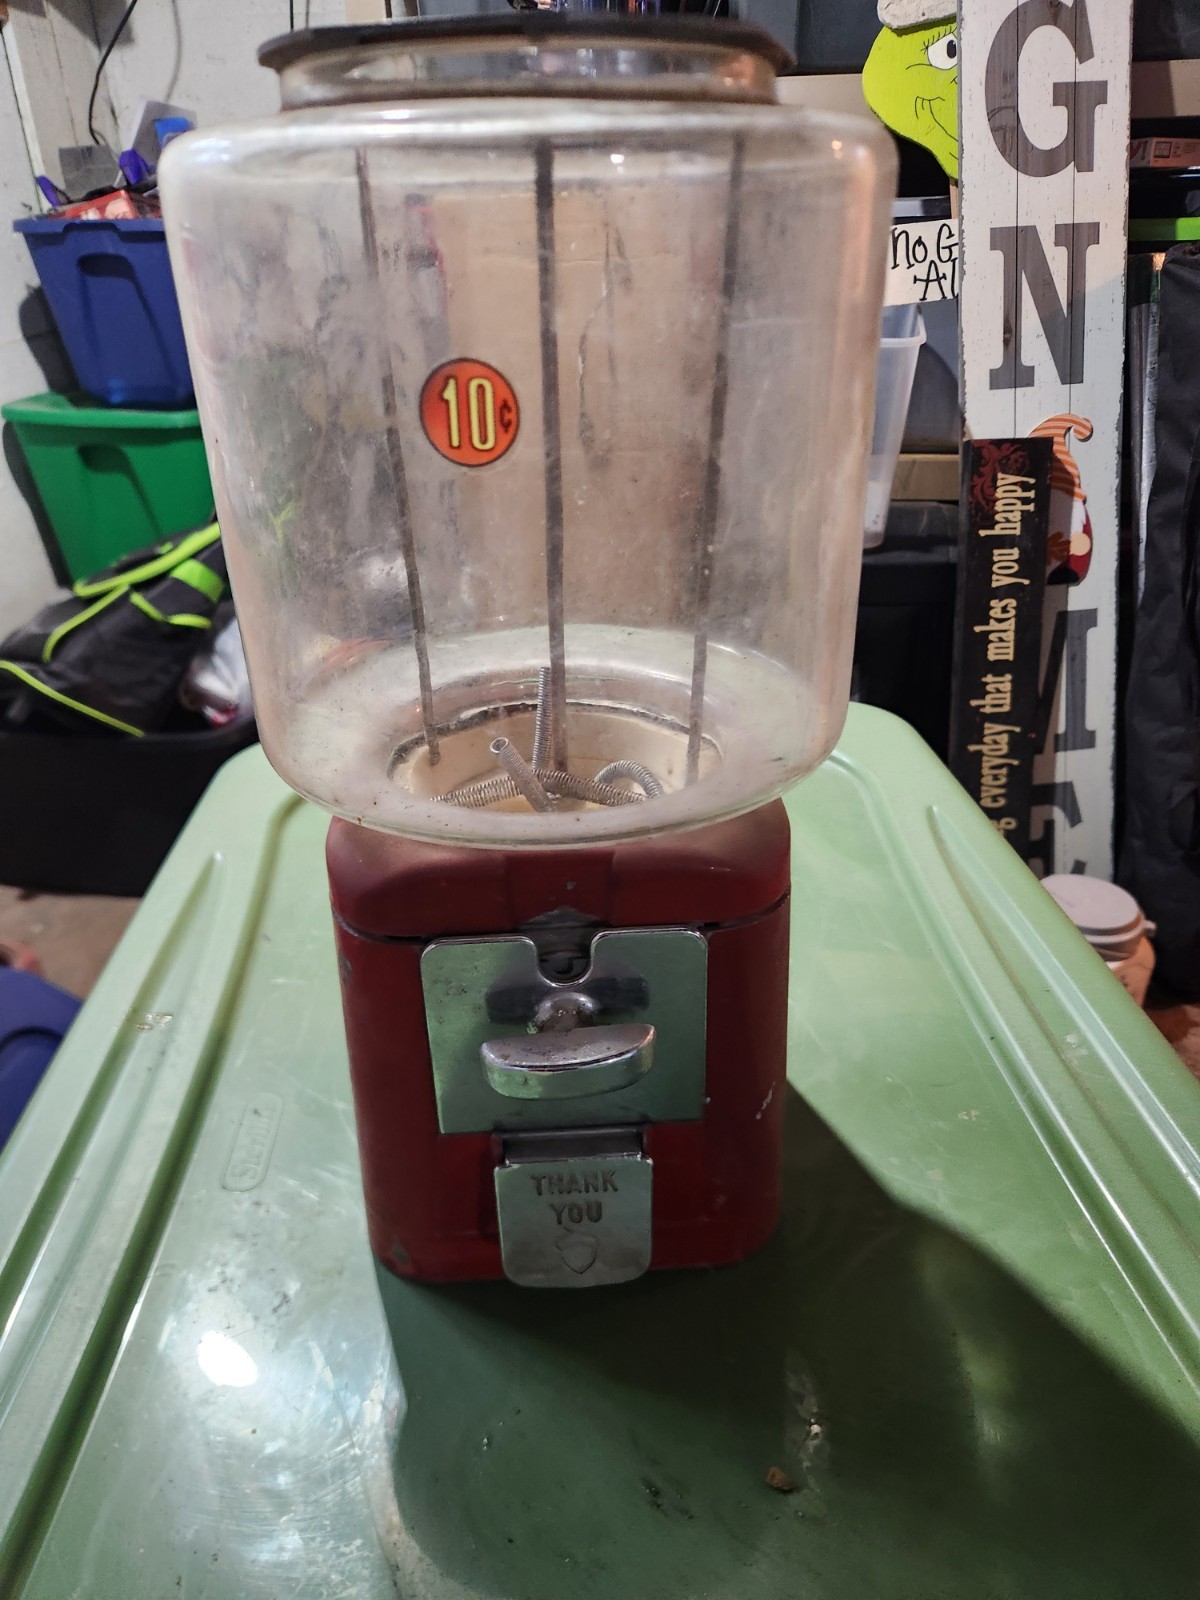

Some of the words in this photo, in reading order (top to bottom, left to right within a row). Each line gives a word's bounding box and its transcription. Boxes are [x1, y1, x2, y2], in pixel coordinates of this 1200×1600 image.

[978, 472, 1036, 536] happy
[991, 547, 1031, 588] you
[973, 598, 1017, 661] makes
[969, 673, 1012, 713] that
[967, 722, 1021, 809] everyday
[530, 1169, 618, 1196] THANK
[550, 1200, 602, 1225] YOU
